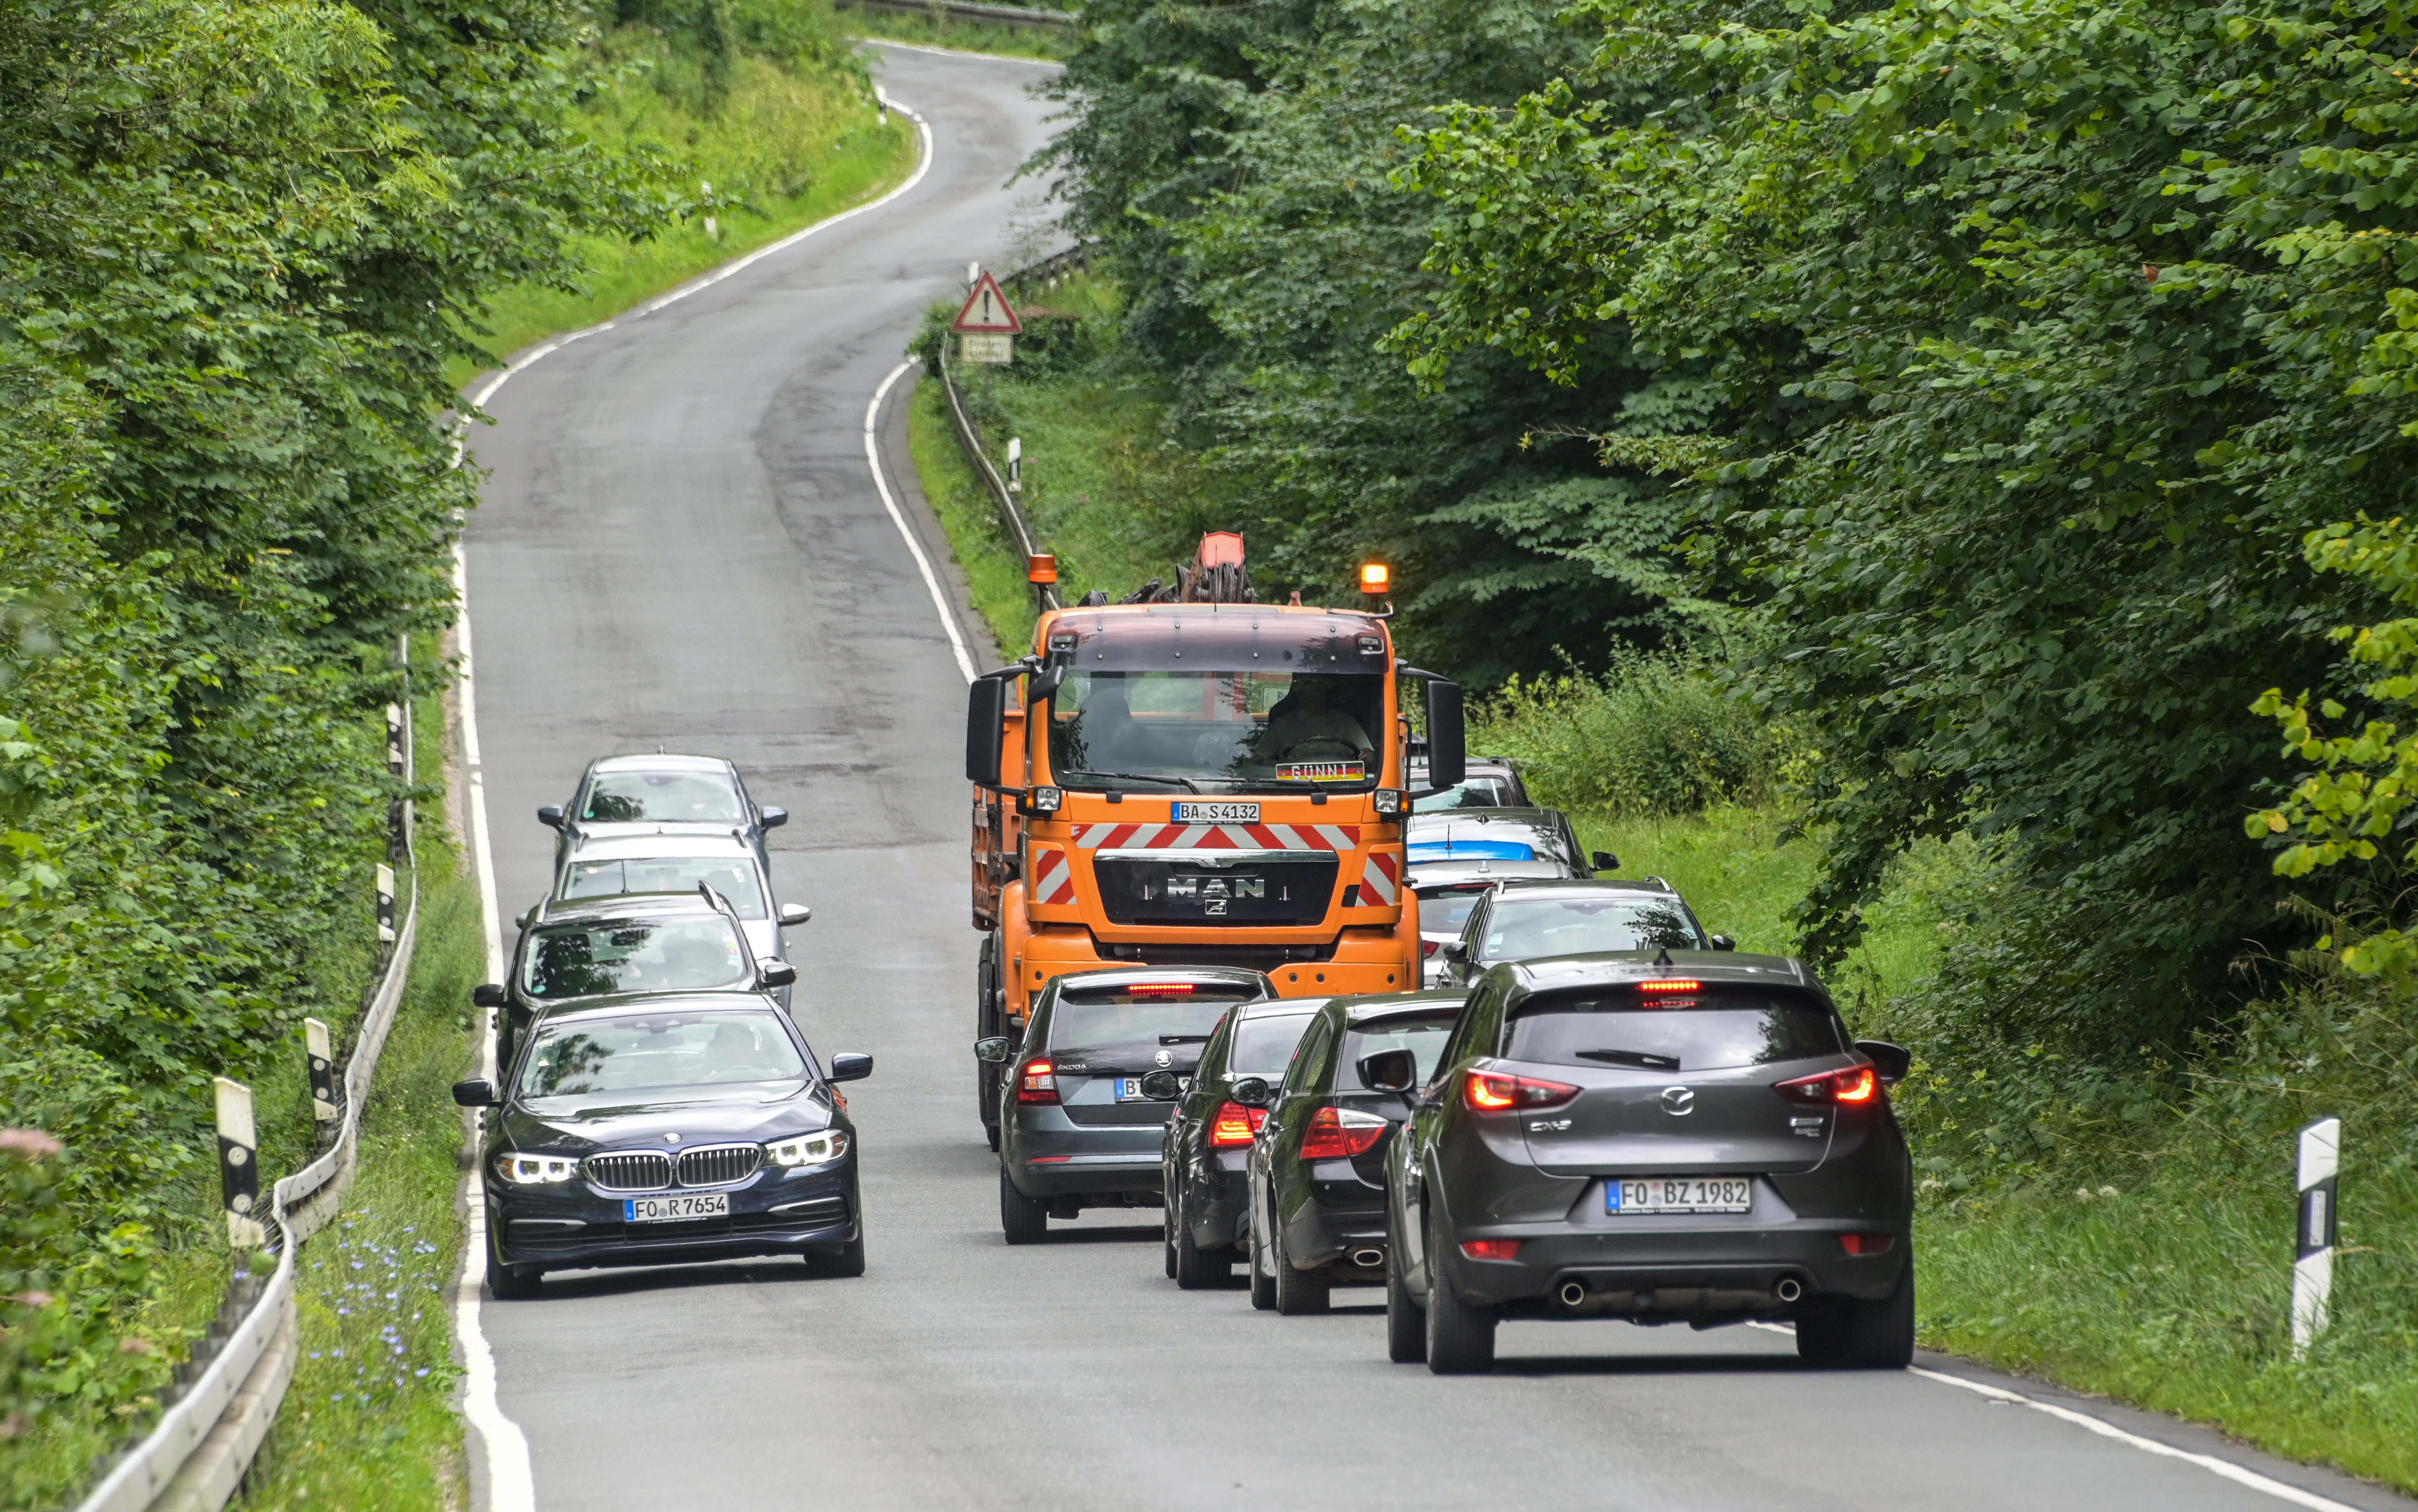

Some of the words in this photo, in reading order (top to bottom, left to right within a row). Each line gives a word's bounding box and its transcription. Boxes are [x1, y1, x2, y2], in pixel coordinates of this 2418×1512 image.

[1181, 805, 1199, 818] BA
[1210, 805, 1218, 818] S
[1222, 805, 1257, 818] 4132
[1168, 879, 1264, 898] MAN
[1622, 1182, 1647, 1205] FO
[1665, 1182, 1689, 1204] BZ
[1696, 1182, 1747, 1204] 1982
[636, 1201, 657, 1218] FO
[669, 1200, 680, 1215] R
[684, 1196, 725, 1214] 7654
